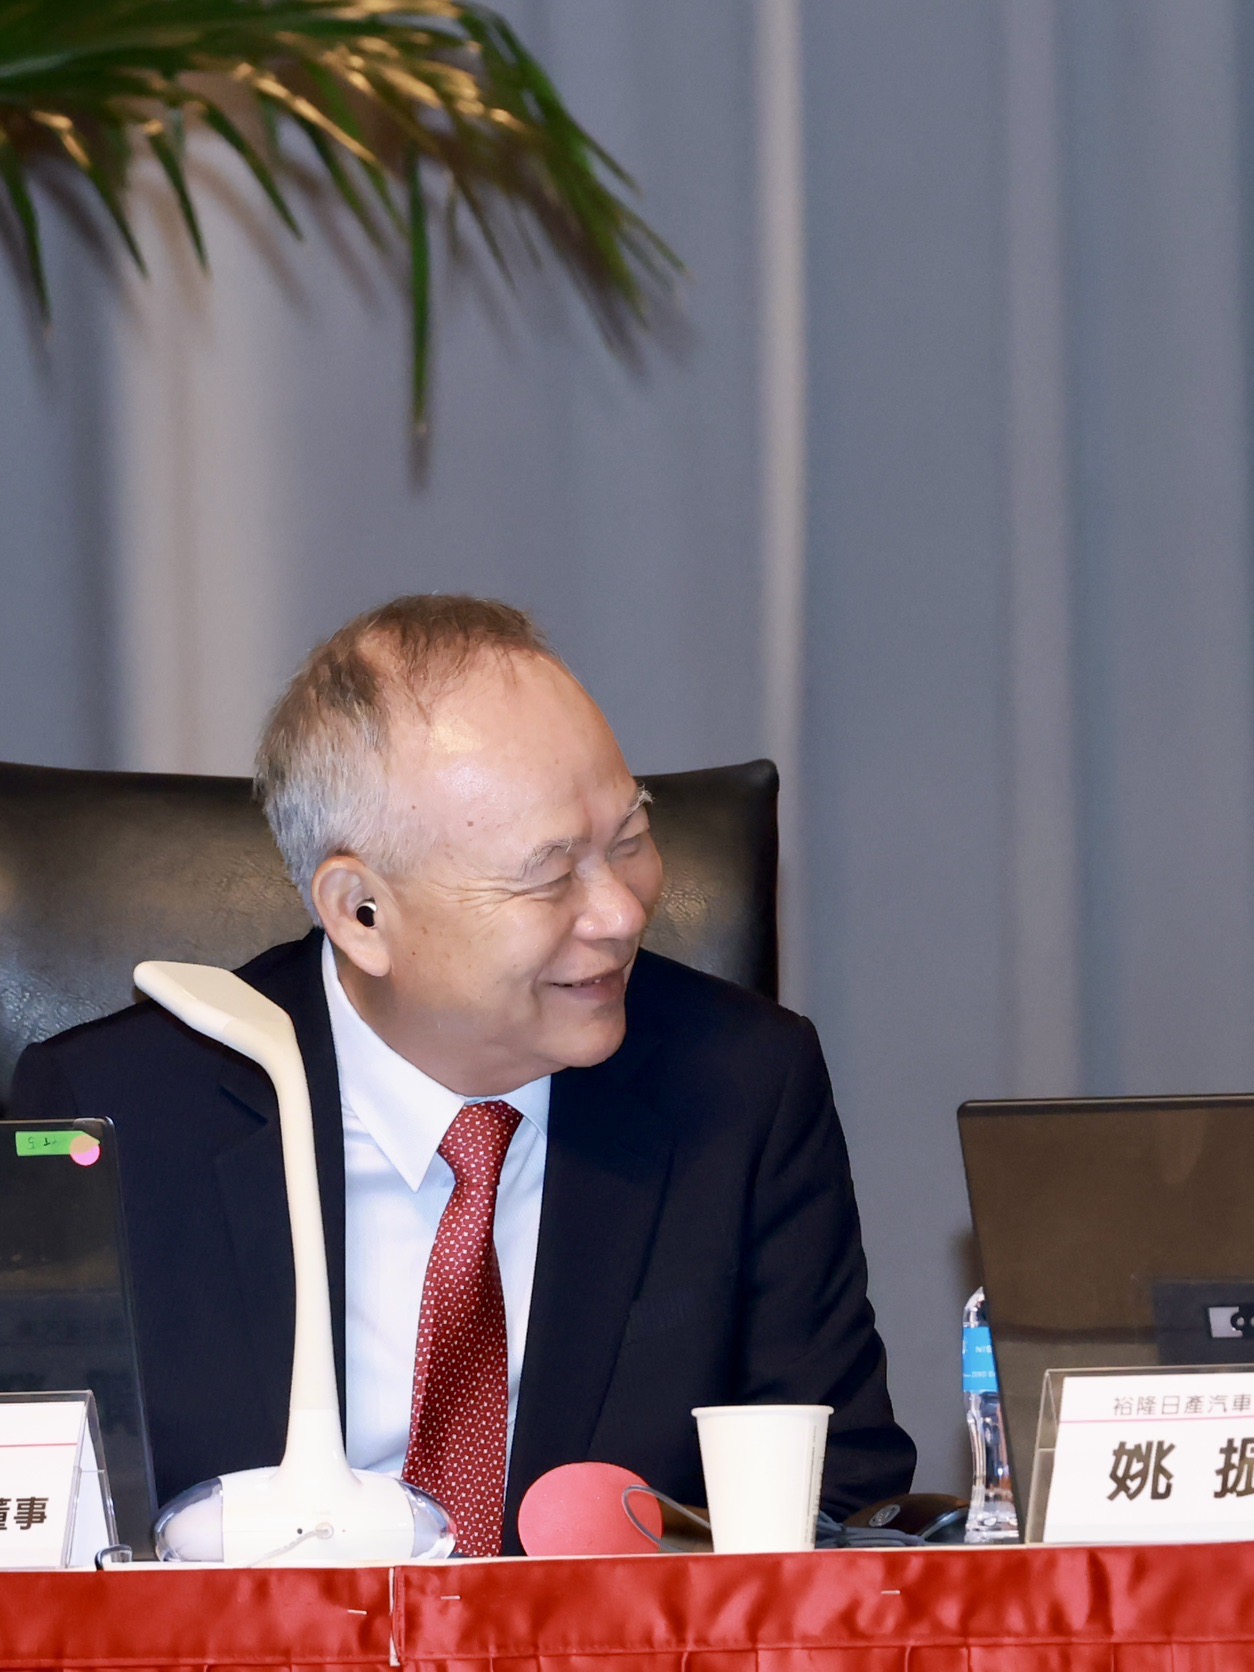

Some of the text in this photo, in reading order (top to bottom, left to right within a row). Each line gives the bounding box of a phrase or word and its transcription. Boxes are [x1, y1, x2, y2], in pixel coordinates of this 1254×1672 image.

[1113, 1394, 1252, 1416] 裕隆日產汽車
